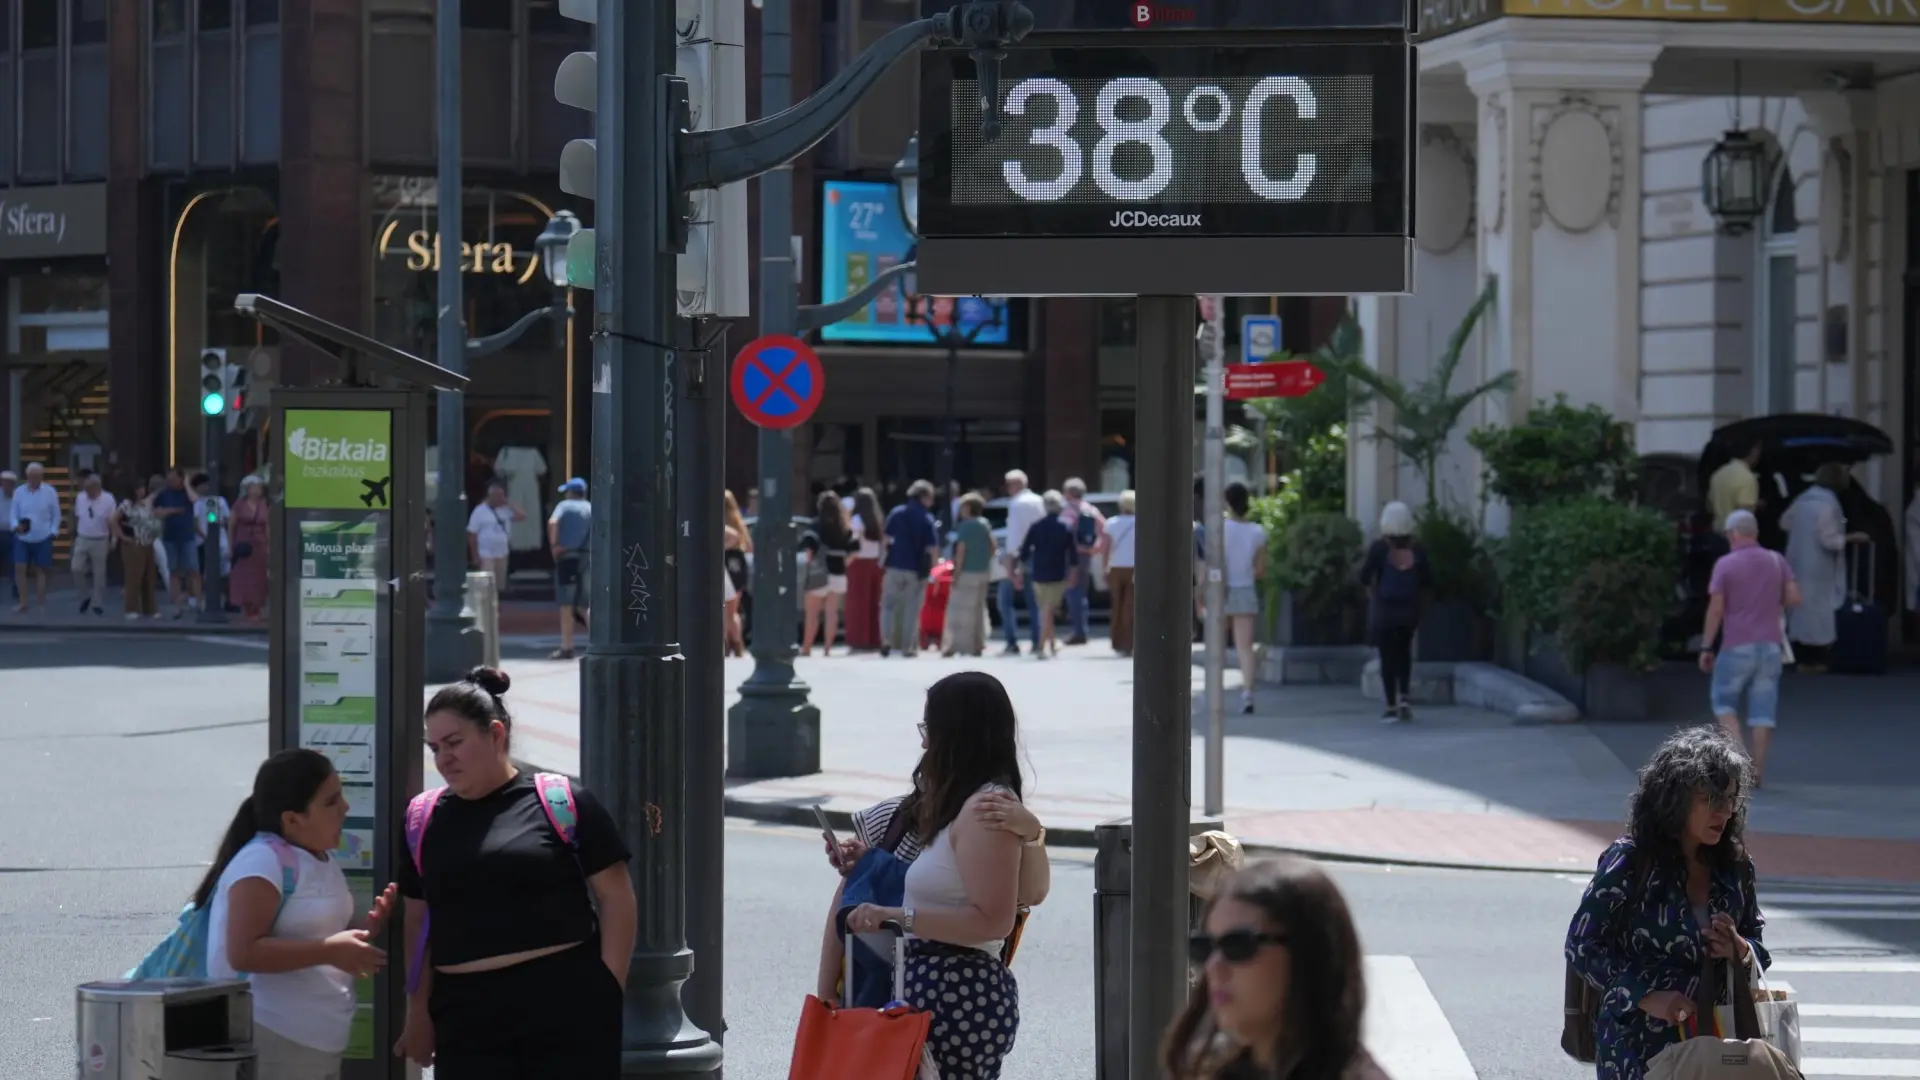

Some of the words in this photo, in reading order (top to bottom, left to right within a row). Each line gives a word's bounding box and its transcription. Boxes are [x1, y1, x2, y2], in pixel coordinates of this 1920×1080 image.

[1003, 76, 1317, 201] 38°C
[1109, 211, 1202, 227] JCDecaux
[303, 437, 387, 461] Bizkaia
[304, 542, 343, 555] Moyua
[344, 541, 375, 556] plaza
